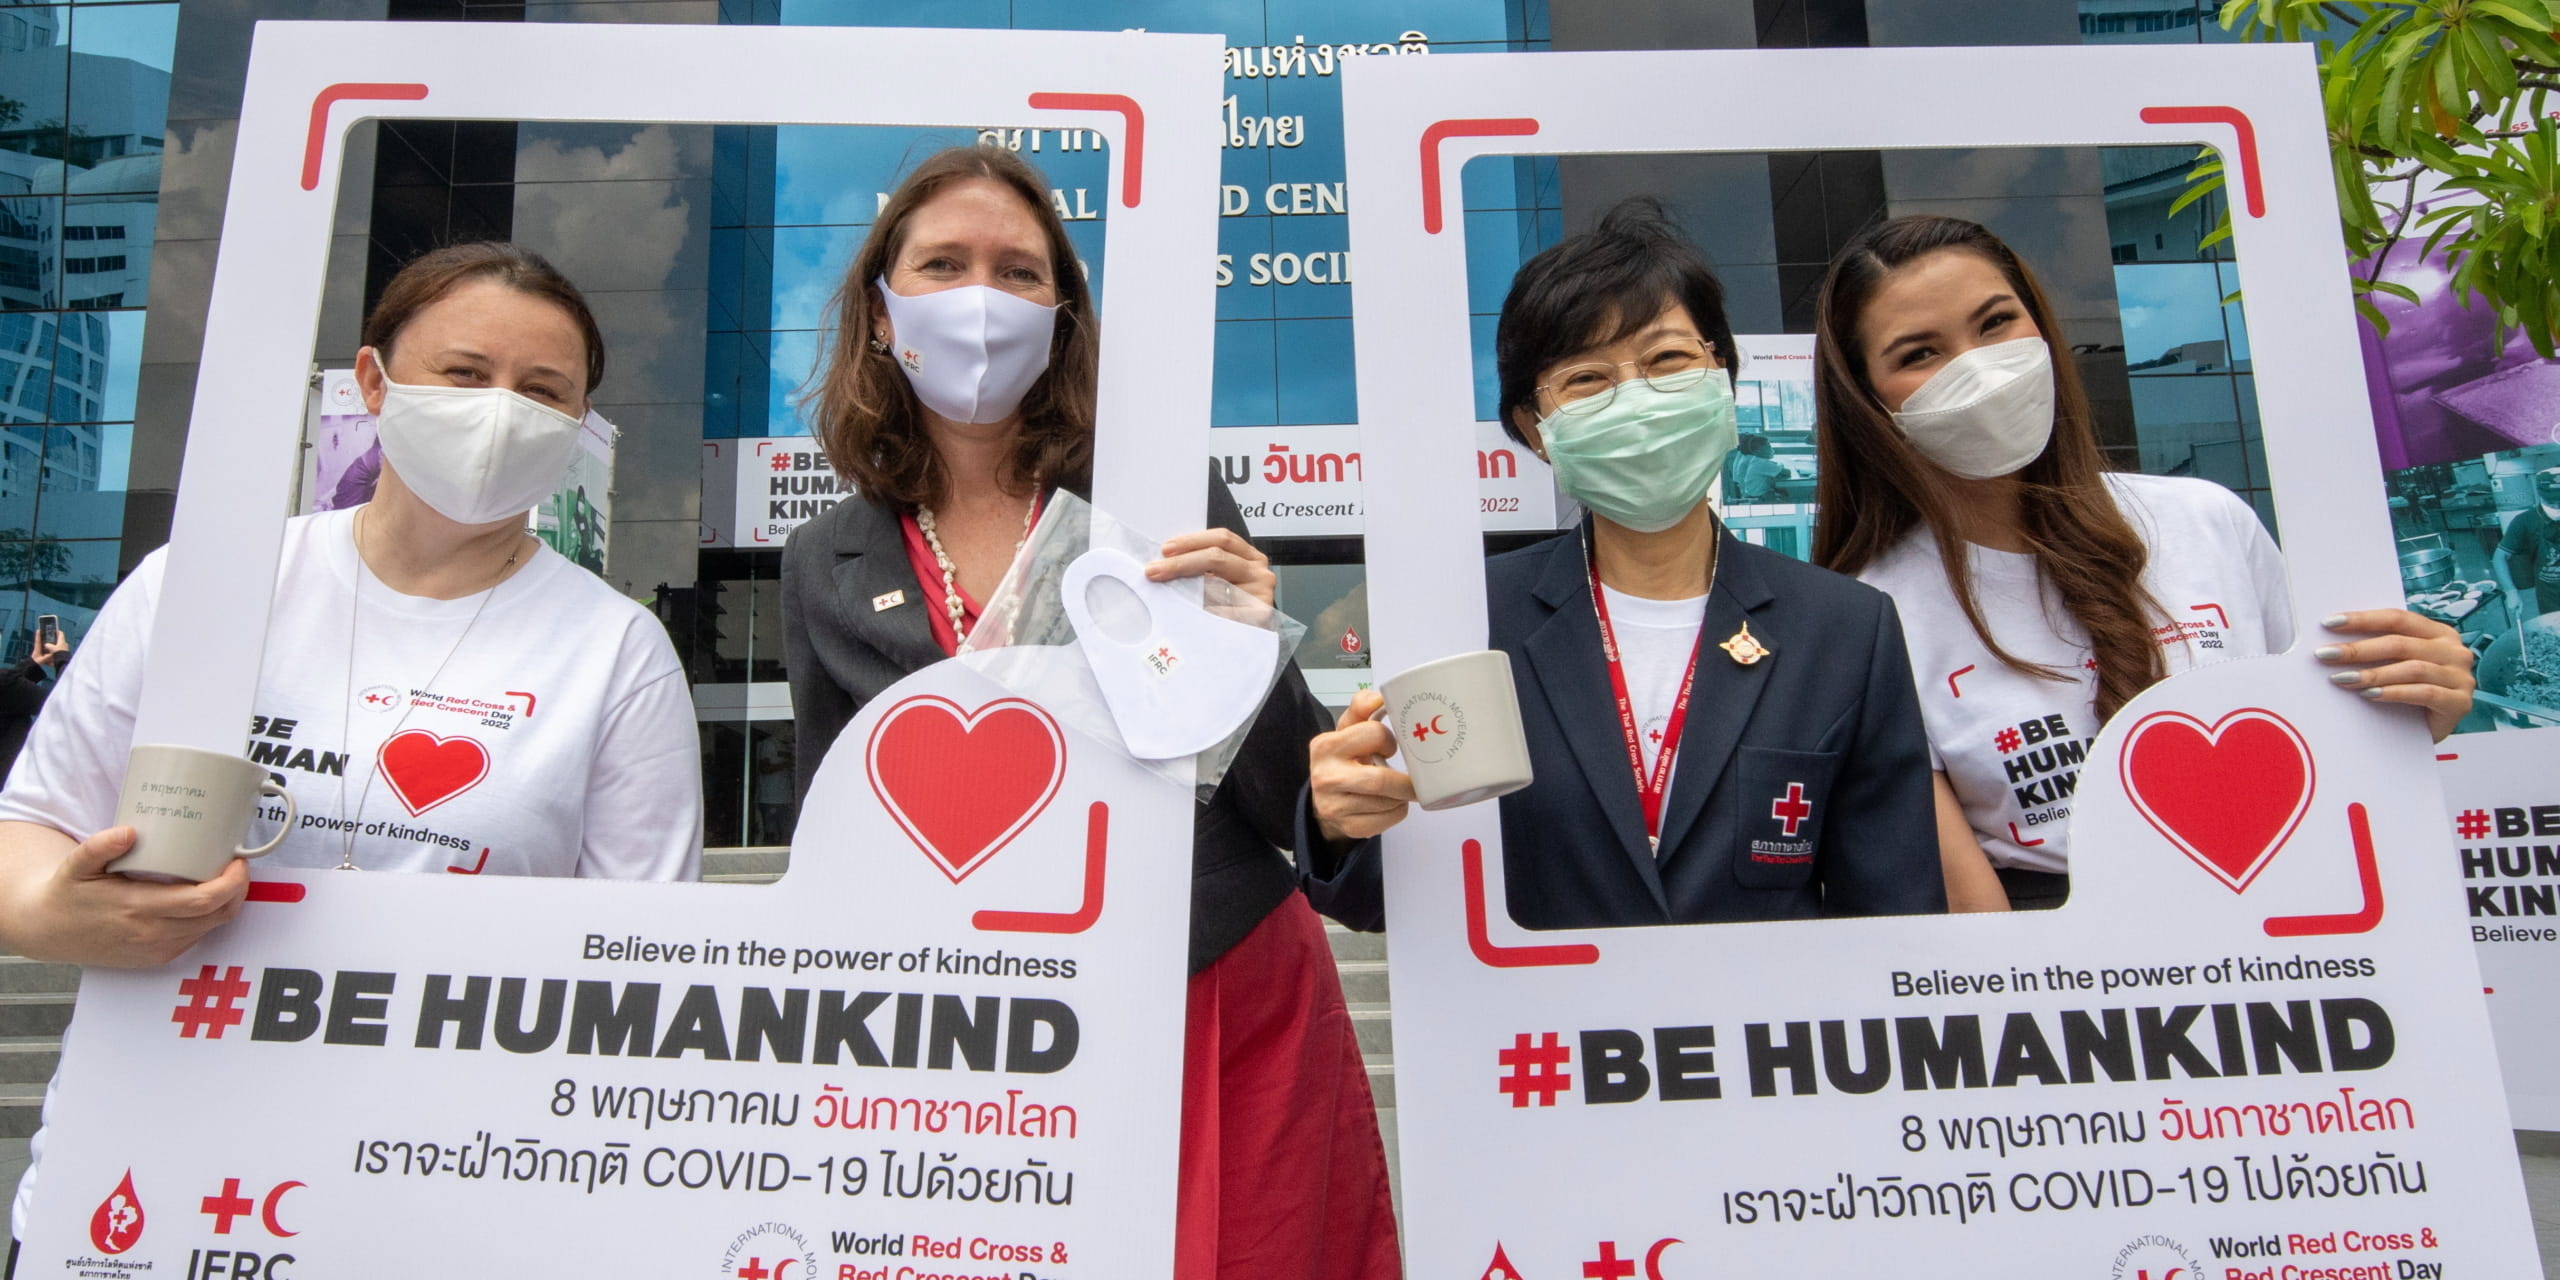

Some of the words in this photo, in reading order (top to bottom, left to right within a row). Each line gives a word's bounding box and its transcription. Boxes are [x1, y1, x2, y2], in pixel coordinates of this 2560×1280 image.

[771, 452, 831, 471] #BE
[1272, 501, 1355, 517] Crescent
[1480, 497, 1519, 511] 2022
[2156, 632, 2200, 646] rescent
[2199, 630, 2219, 639] Day
[2200, 640, 2224, 648] 2022
[1148, 654, 1168, 675] IFRC
[410, 689, 443, 701] World
[446, 696, 470, 705] Red
[472, 700, 505, 711] Cross
[507, 704, 516, 712] &
[410, 699, 433, 707] Red
[437, 703, 489, 717] Crescent
[490, 711, 513, 721] Day
[481, 719, 510, 730] 2022
[1618, 697, 1626, 711] The
[1626, 728, 1635, 743] Red
[1994, 713, 2070, 754] #BE
[247, 740, 351, 777] MAN
[2014, 770, 2080, 809] KIN
[301, 814, 362, 832] power
[365, 822, 386, 837] of
[388, 823, 471, 851] kindness
[2456, 805, 2560, 840] #BE
[2466, 884, 2560, 917] KIN
[2471, 925, 2557, 942] Believe
[583, 934, 696, 963] Believe
[703, 939, 729, 965] in
[737, 940, 786, 967] the
[793, 949, 893, 974] power
[898, 947, 930, 972] of
[936, 948, 1077, 979] kindness
[1891, 970, 2004, 997] Believe
[2011, 967, 2038, 992] in
[2044, 965, 2094, 990] the
[2101, 966, 2196, 994] power
[2203, 958, 2232, 984] of
[2238, 954, 2376, 982] kindness
[171, 965, 397, 1046] #BE
[414, 974, 1079, 1074] HUMANKIND
[1499, 1025, 1722, 1108] #BE
[1744, 998, 2395, 1097] HUMANKIND
[551, 1079, 576, 1117] 8
[592, 1085, 799, 1130] พฤษภาคม
[814, 1083, 1076, 1139] วันกาชาดโลก
[1901, 1115, 1926, 1152] 8
[1938, 1110, 2146, 1158] พฤษภาคม
[2159, 1087, 2414, 1141] วันกาชาดโลก
[355, 1130, 630, 1194] เราจะฝ่าวิกฤติ
[643, 1147, 867, 1196] COVID-19
[880, 1150, 1073, 1206] ไปด้วยกัน
[1724, 1172, 1996, 1224] เราจะฝ่าวิกฤติ
[2009, 1166, 2228, 1212] COVID-19
[2234, 1151, 2427, 1201] ไปด้วยกัน
[721, 1222, 809, 1273] INTERNATIONAL
[832, 1231, 904, 1256] World
[912, 1235, 962, 1259] Red
[970, 1237, 1043, 1263] Cross
[1050, 1242, 1068, 1264] &
[2209, 1234, 2282, 1259] World
[2288, 1232, 2337, 1255] Red
[2343, 1231, 2414, 1252] Cross
[2421, 1227, 2438, 1248] &
[187, 1249, 296, 1280] IFRC
[2397, 1259, 2442, 1280] Day
